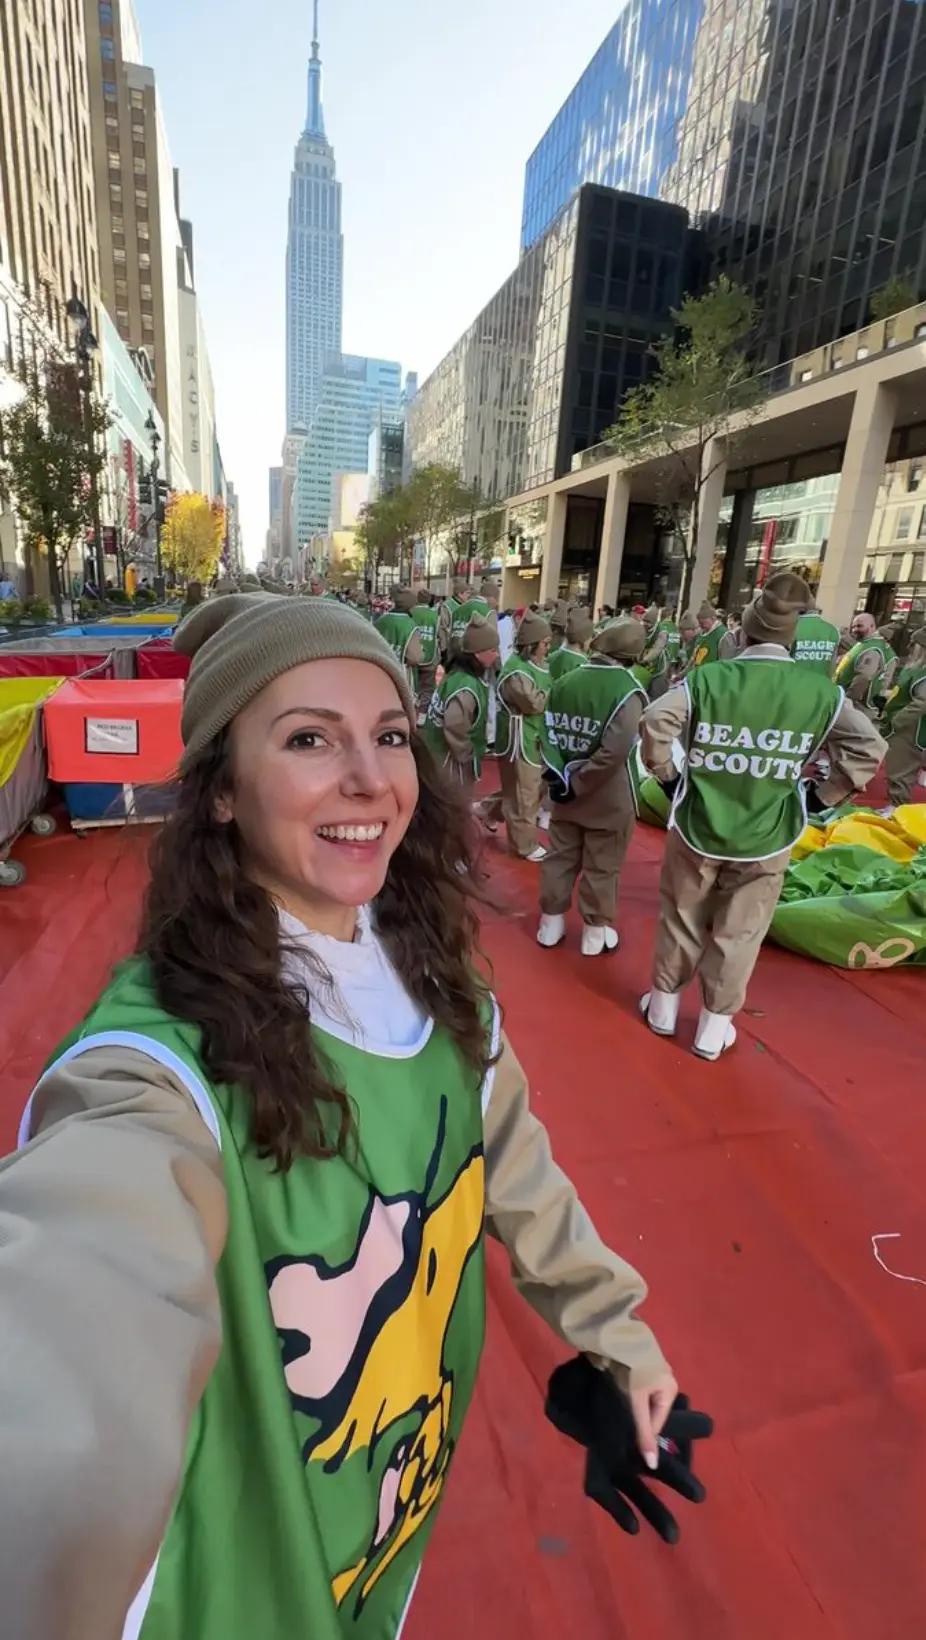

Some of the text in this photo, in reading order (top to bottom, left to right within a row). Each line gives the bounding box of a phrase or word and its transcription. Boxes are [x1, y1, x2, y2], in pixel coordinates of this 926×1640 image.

[795, 650, 833, 661] SCOUT
[694, 722, 815, 755] BEAGLE
[688, 747, 806, 780] SCOUTS
